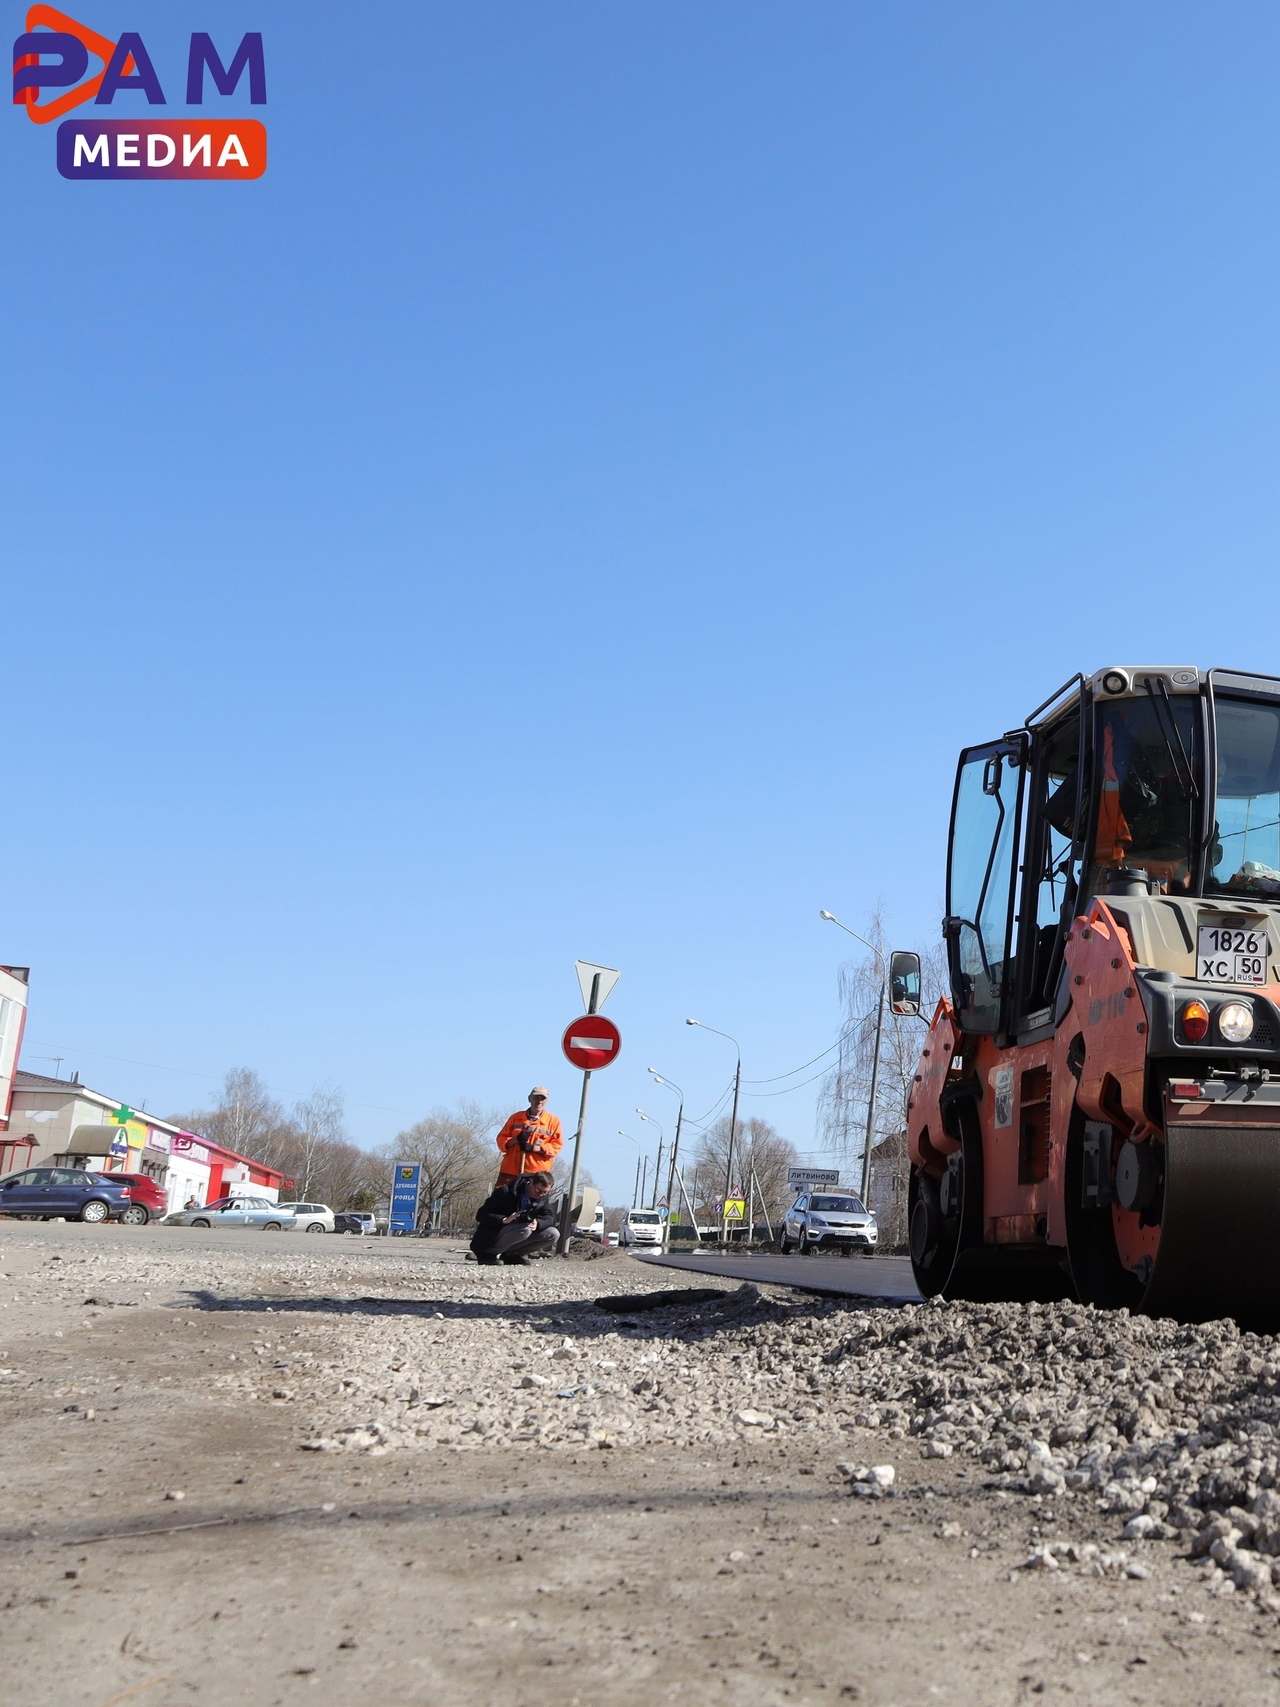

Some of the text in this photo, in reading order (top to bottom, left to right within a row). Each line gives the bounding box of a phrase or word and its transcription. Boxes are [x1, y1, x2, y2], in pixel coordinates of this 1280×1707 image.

[1209, 930, 1259, 953] 1826
[1242, 958, 1261, 974] 50
[791, 1172, 836, 1181] ЛИТВИНОВО
